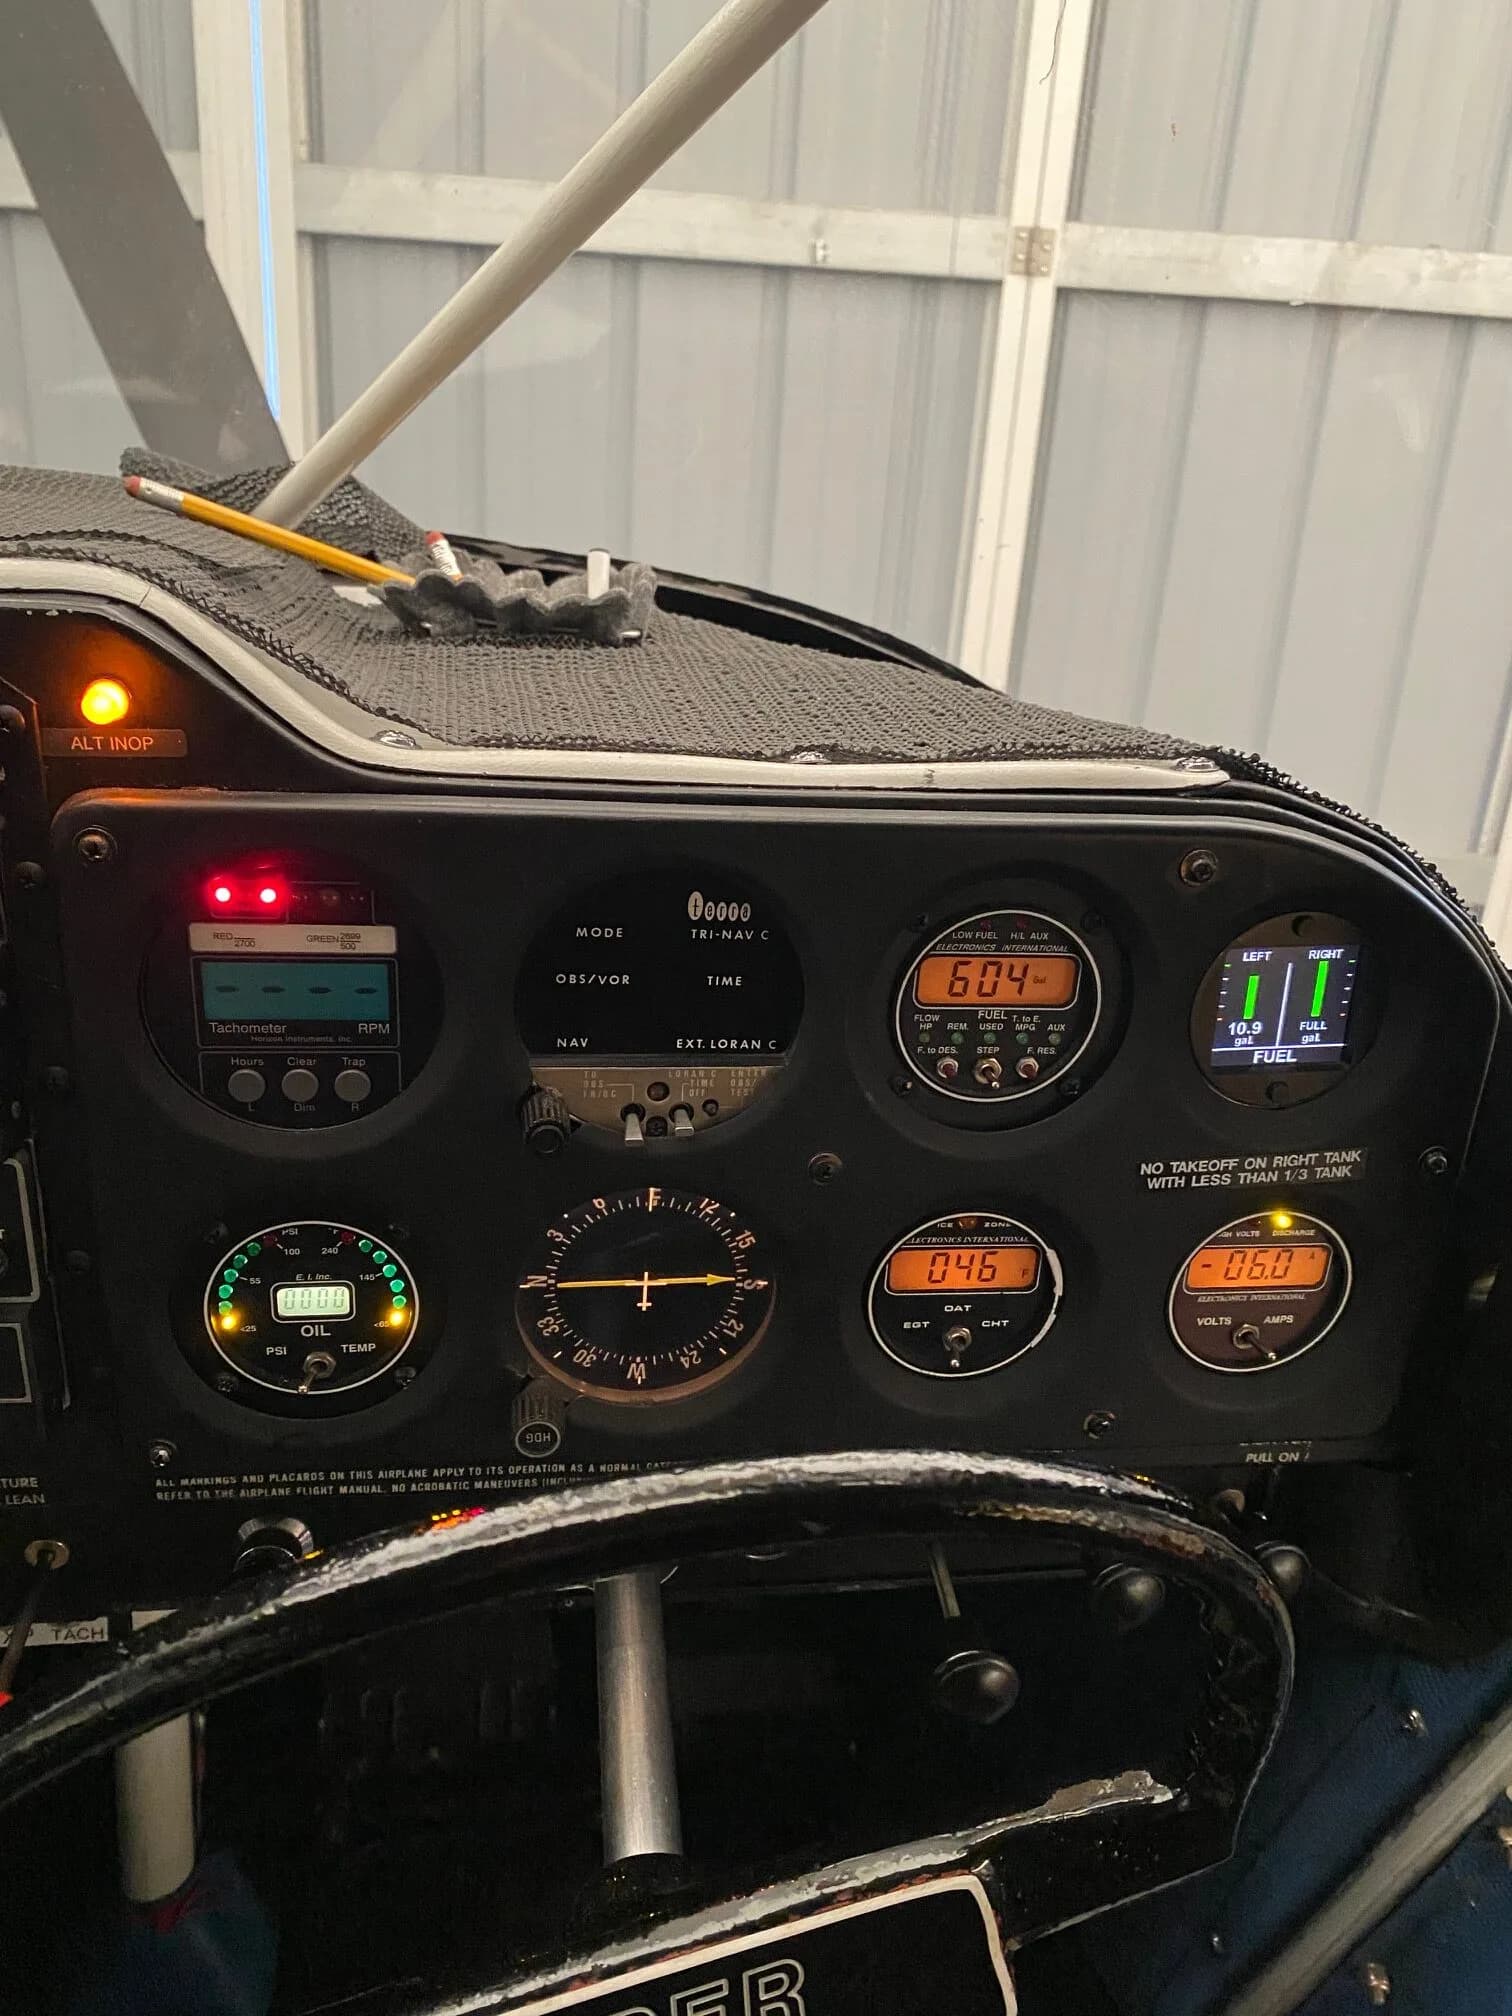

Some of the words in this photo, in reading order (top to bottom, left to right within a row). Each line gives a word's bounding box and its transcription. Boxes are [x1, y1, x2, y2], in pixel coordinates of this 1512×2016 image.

[71, 736, 102, 751] ALT
[110, 736, 154, 752] INOP
[687, 891, 751, 923] terra
[213, 932, 234, 940] RED
[575, 927, 625, 938] MODE
[690, 929, 755, 940] TRI-NAV
[760, 930, 770, 940] C
[952, 931, 974, 940] LOW
[975, 931, 998, 940] FUEL
[1030, 931, 1049, 941] AUX
[307, 935, 339, 943] GREEN
[1001, 944, 1069, 952] INTERNATIONAL
[1242, 951, 1272, 962] LEFT
[1308, 949, 1345, 960] RIGHT
[555, 974, 631, 985] OBS/VOR
[707, 975, 743, 986] TIME
[913, 1014, 940, 1022] FLOW
[977, 1010, 1008, 1020] FUEL
[209, 1022, 287, 1034] Tachometer
[358, 1023, 391, 1034] RPM
[978, 1023, 1004, 1031] USED
[1015, 1023, 1036, 1031] MPG
[1047, 1023, 1066, 1031] AUX
[1228, 1021, 1263, 1036] 10.9
[1299, 1020, 1329, 1031] FULL
[556, 1037, 589, 1048] NAV
[676, 1038, 706, 1048] EXT.
[710, 1039, 761, 1049] LORAN
[768, 1039, 777, 1049] C
[976, 1046, 1000, 1054] STEP
[231, 1057, 265, 1066] Hours
[287, 1057, 318, 1066] Clear
[341, 1057, 367, 1068] Trap
[1252, 1050, 1299, 1064] FUEL
[248, 1103, 256, 1112] L
[294, 1103, 316, 1112] Dim
[351, 1103, 360, 1112] R
[1139, 1162, 1165, 1176] NO
[1169, 1158, 1240, 1174] TAKEOFF
[1244, 1157, 1268, 1170] ON
[1272, 1153, 1320, 1168] RIGHT
[1323, 1149, 1363, 1164] TANK
[1147, 1175, 1186, 1190] WITH
[1191, 1173, 1232, 1188] LESS
[1237, 1170, 1278, 1185] THAN
[1283, 1168, 1308, 1182] 1/3
[1314, 1165, 1353, 1180] TANK
[546, 1229, 565, 1242] 3
[1236, 1230, 1260, 1238] VOLTS
[1272, 1229, 1316, 1237] DISCHARGE
[735, 1229, 757, 1249] 15
[961, 1236, 1030, 1244] INTERNATIONAL
[283, 1248, 300, 1256] 100
[321, 1247, 339, 1255] 240
[927, 1250, 999, 1284] 046
[359, 1273, 375, 1281] 145
[283, 1287, 345, 1310] 0000
[903, 1321, 931, 1329] EGT
[981, 1320, 1010, 1328] CHT
[1196, 1316, 1232, 1326] VOLTS
[1263, 1315, 1294, 1324] AMPS
[300, 1325, 331, 1337] OIL
[536, 1316, 560, 1337] 33
[265, 1347, 288, 1356] PSI
[340, 1343, 376, 1353] TEMP
[626, 1363, 647, 1379] W
[1245, 1452, 1273, 1463] PULL
[1278, 1451, 1300, 1462] ON
[155, 1479, 175, 1487] ALL
[242, 1475, 264, 1483] AND
[350, 1470, 373, 1480] THIS
[378, 1469, 428, 1479] AIRPLANE
[433, 1468, 465, 1478] APPLY
[469, 1466, 482, 1476] TO
[486, 1465, 504, 1475] ITS
[508, 1464, 565, 1475] OPERATION
[570, 1463, 583, 1473] AS
[588, 1463, 595, 1473] A
[600, 1462, 640, 1473] NORMAL
[240, 1488, 291, 1497] AIRPLANE
[296, 1486, 334, 1496] FLIGHT
[391, 1483, 406, 1493] NO
[410, 1481, 469, 1492] ACROBATIC
[474, 1478, 538, 1489] MANEUVERS
[5, 1493, 45, 1505] LEAN
[50, 1628, 104, 1641] TACH
